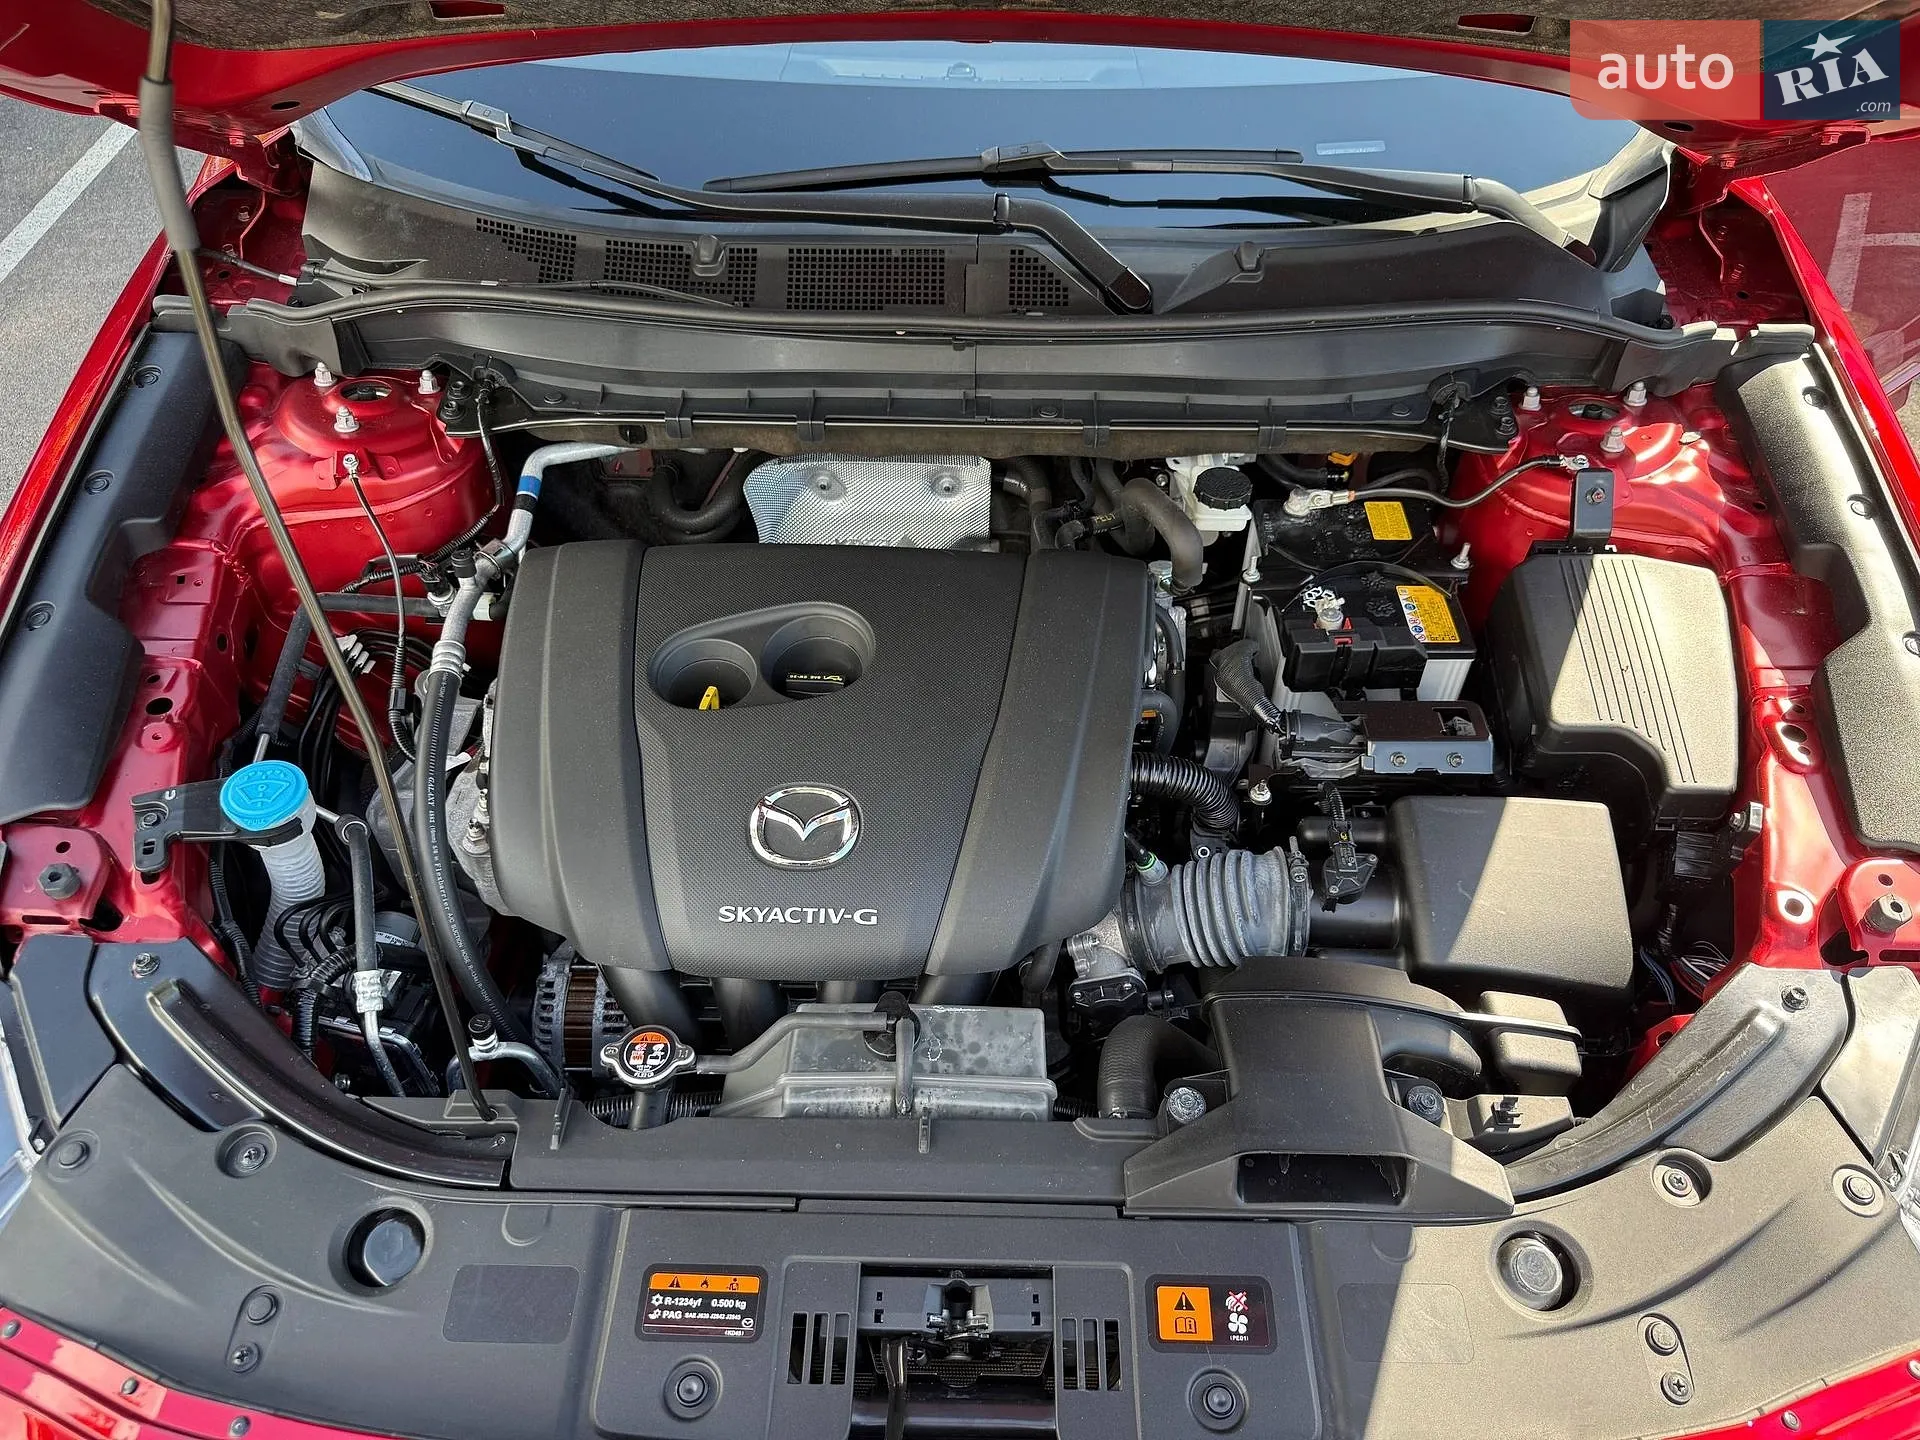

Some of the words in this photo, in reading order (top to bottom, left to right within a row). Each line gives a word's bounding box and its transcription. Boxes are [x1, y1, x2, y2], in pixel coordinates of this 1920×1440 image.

[427, 777, 435, 806] GALAXY
[451, 923, 463, 948] SUCTION
[718, 905, 878, 925] SKYACTIV-G
[664, 1296, 703, 1309] R-1234yf
[711, 1298, 734, 1308] 0.500
[735, 1299, 747, 1310] kg
[662, 1309, 682, 1320] PAG
